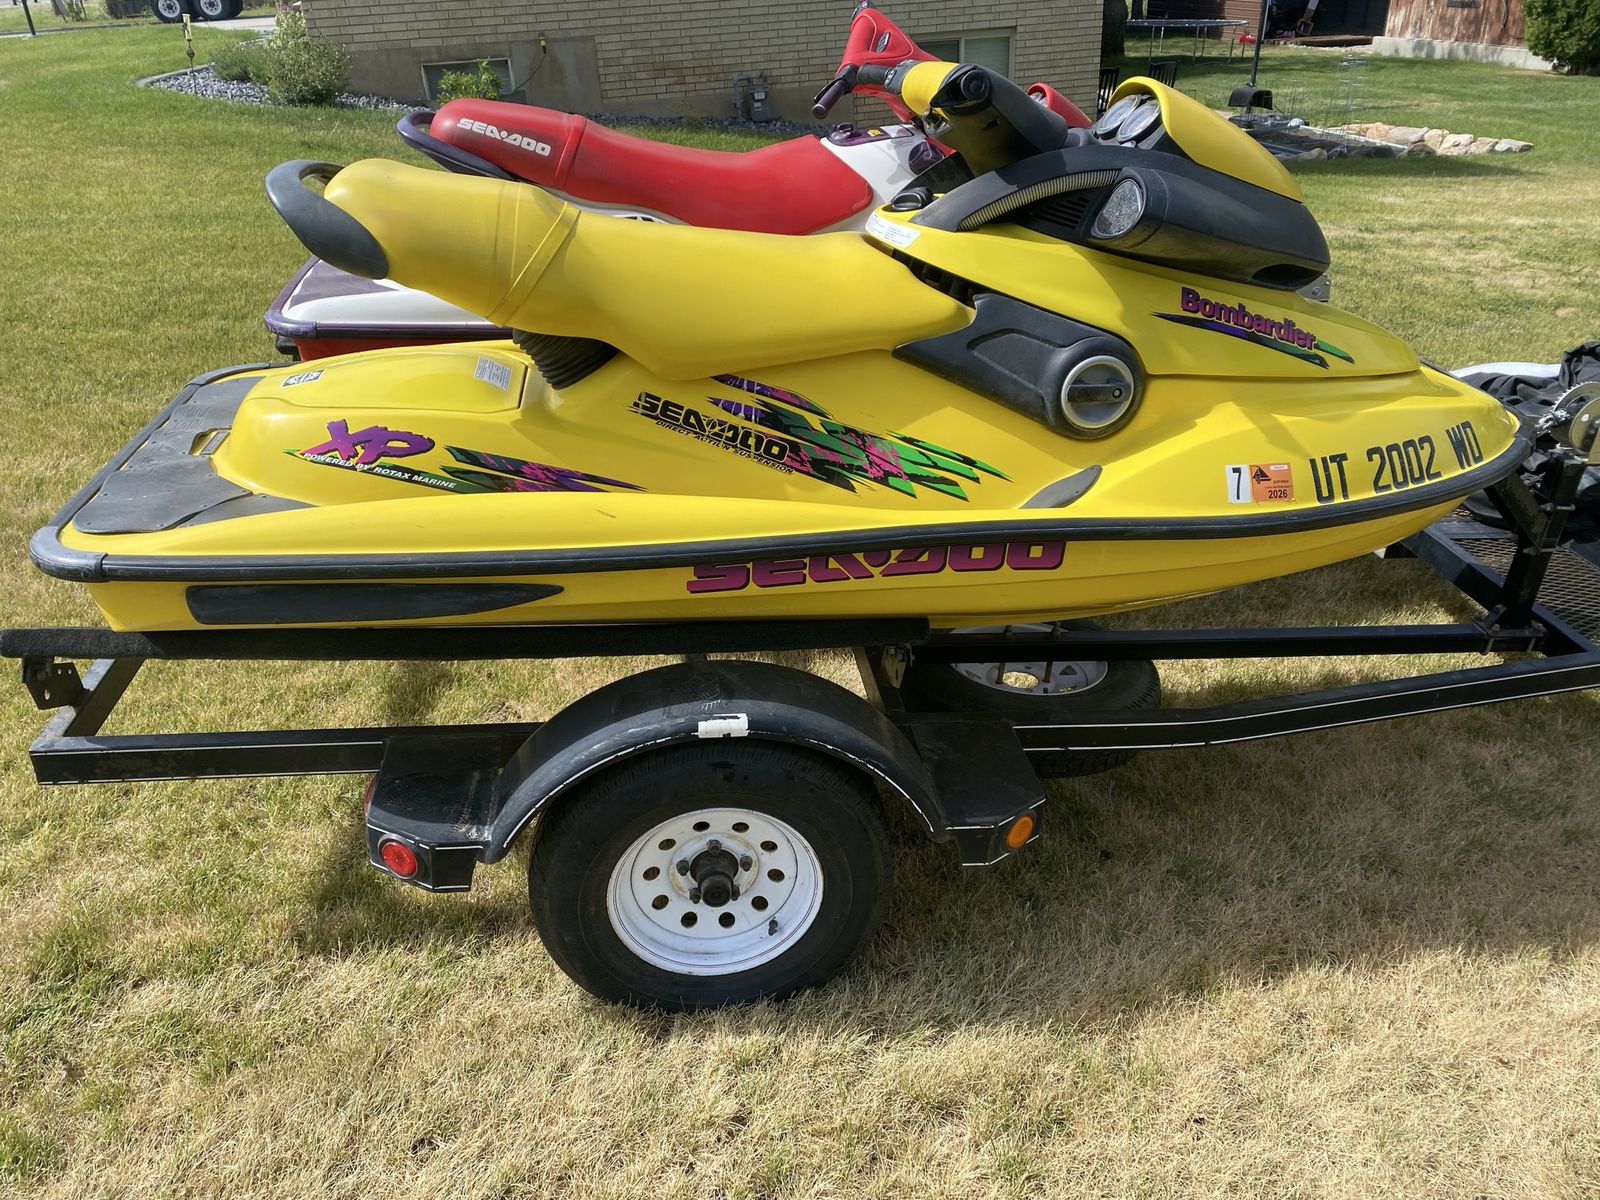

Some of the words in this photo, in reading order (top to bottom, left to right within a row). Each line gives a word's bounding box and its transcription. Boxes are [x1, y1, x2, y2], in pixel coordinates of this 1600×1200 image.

[1180, 285, 1317, 350] Bombardier
[299, 418, 436, 465] XP
[655, 420, 694, 437] DIRECT
[302, 452, 354, 468] POWERED
[355, 462, 372, 471] BY
[373, 466, 411, 480] ROTAX
[411, 474, 457, 489] MARINE
[1231, 467, 1242, 500] 7
[1309, 452, 1350, 504] UT
[1366, 435, 1442, 494] 2002
[1268, 489, 1288, 499] 2026
